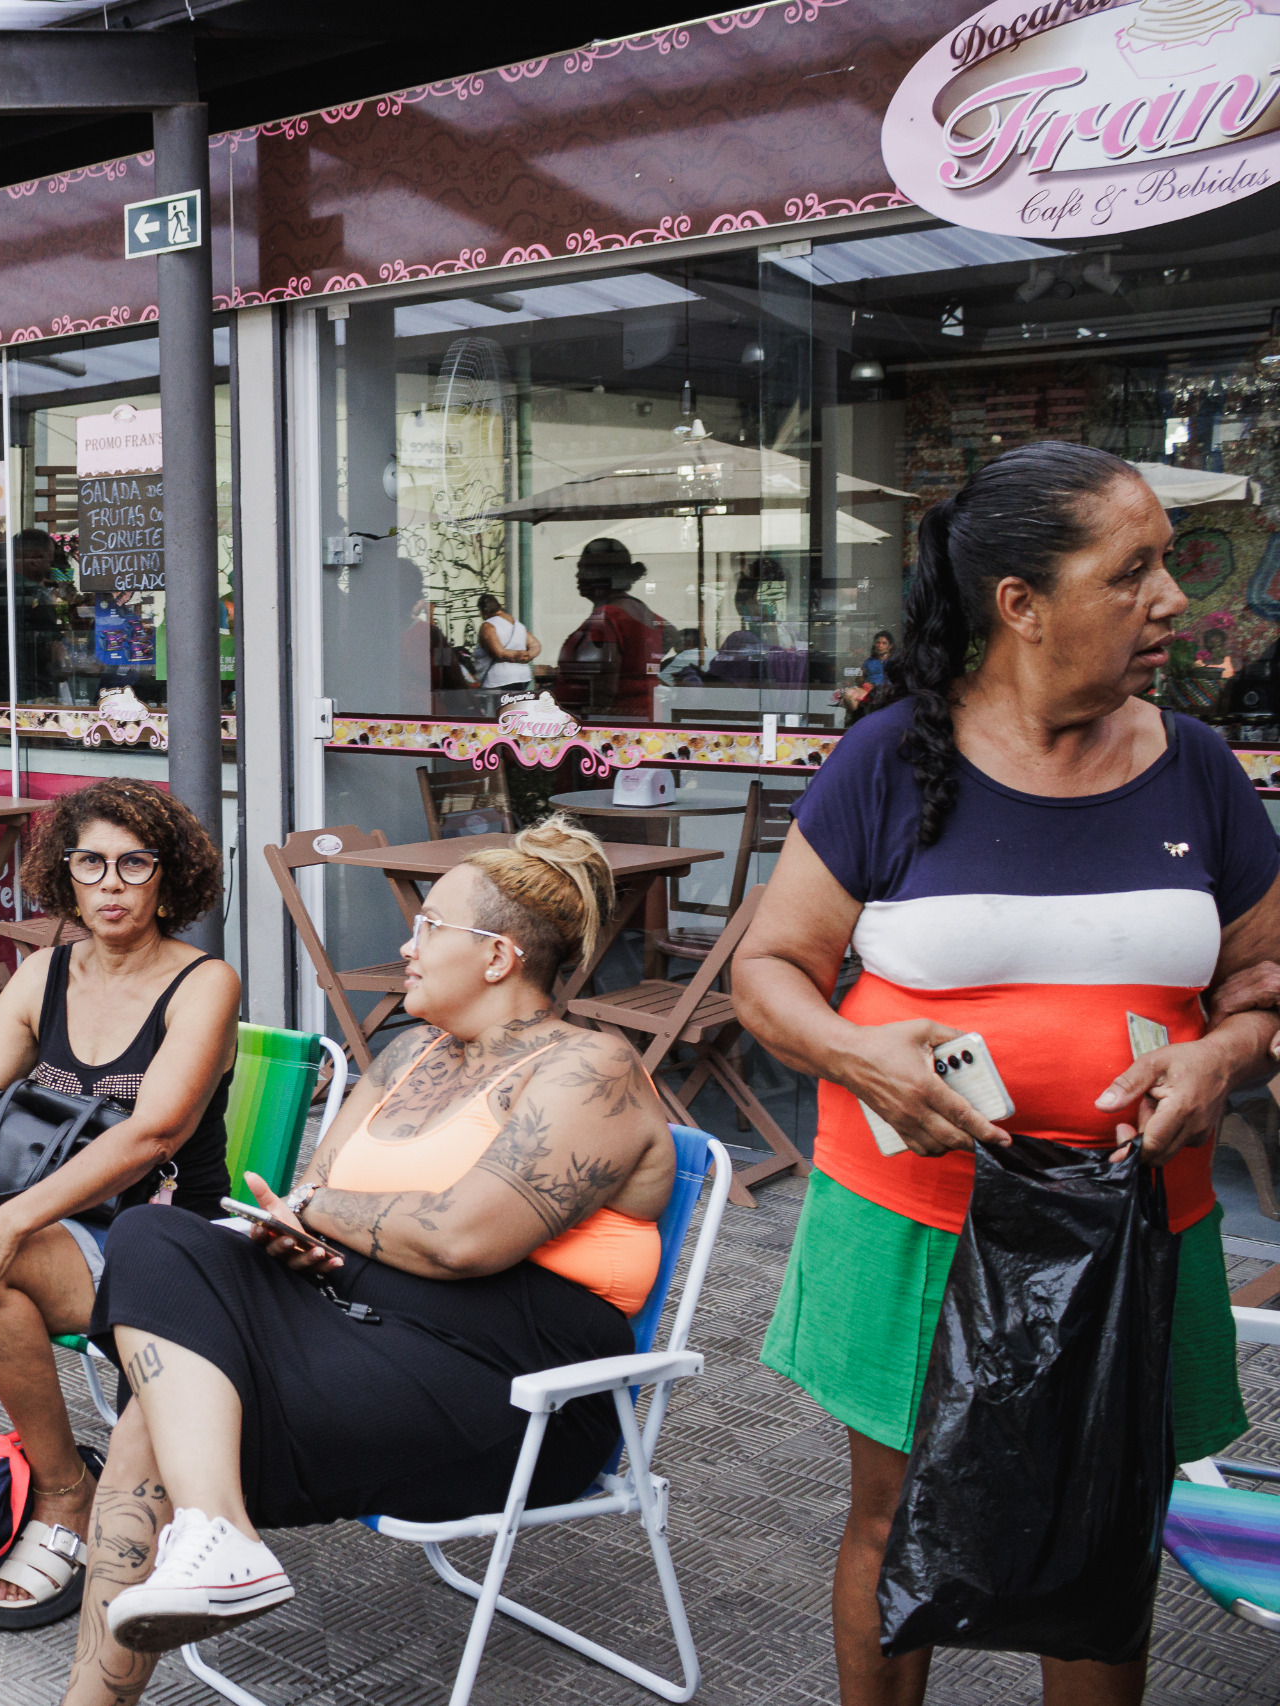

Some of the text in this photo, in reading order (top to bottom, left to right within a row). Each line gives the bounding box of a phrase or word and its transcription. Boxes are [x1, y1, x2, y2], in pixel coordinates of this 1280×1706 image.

[1017, 159, 1271, 232] Café & Bebidas
[85, 436, 122, 451] PROMO
[81, 480, 163, 505] SALADA DE
[87, 505, 145, 528] FRUTAS
[90, 527, 163, 553] SORVETE
[82, 552, 160, 576] CAPUCCINO
[500, 691, 535, 706] Doçaria
[497, 710, 581, 737] Fran's
